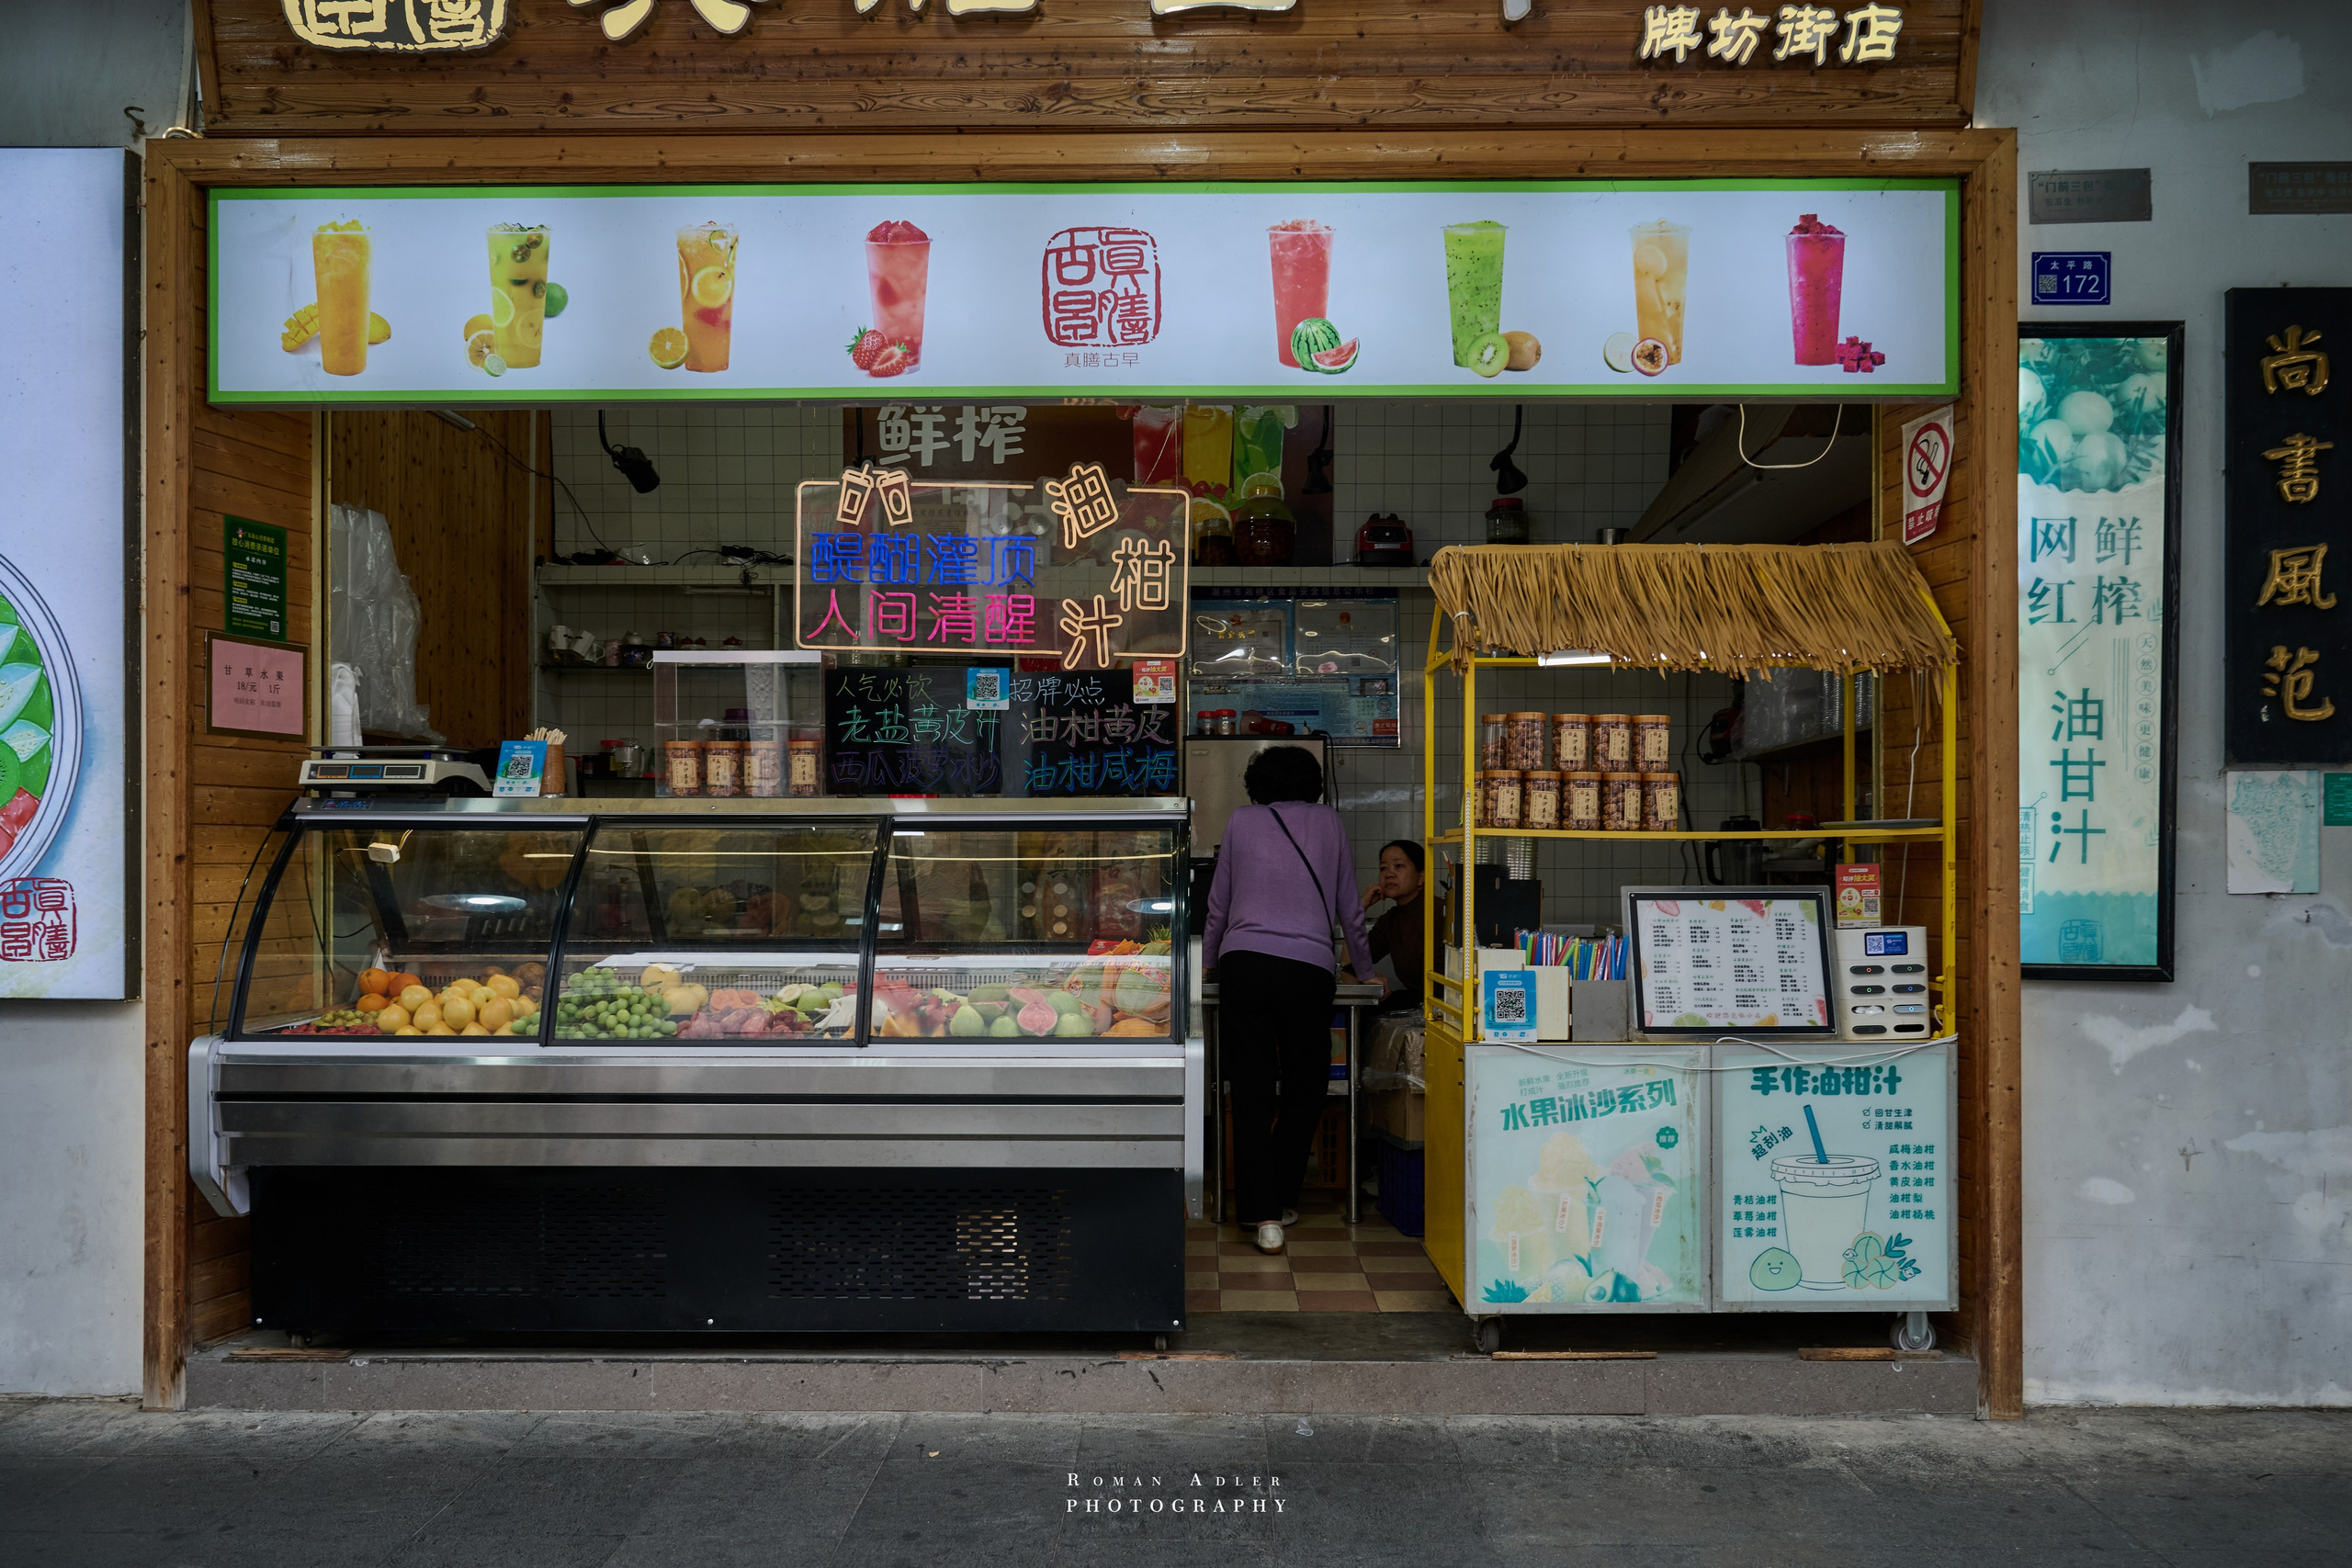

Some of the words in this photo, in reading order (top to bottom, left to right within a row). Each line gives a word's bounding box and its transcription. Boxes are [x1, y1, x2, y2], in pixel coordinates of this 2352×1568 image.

[1640, 3, 1903, 65] 牌坊街店
[2051, 260, 2093, 270] 太平路
[2063, 275, 2100, 293] 172
[1064, 352, 1140, 368] 真膳古早
[876, 406, 1027, 467] 鲜榨
[811, 532, 1036, 587] 醍醐灌顶
[807, 588, 1035, 643] 人间清醒
[224, 665, 284, 681] 甘草水果
[237, 682, 257, 693] 18/元
[268, 684, 281, 694] 1斤
[836, 674, 943, 708] 人气必饮
[1009, 678, 1105, 705] 招牌必点
[2137, 635, 2155, 780] 天然美味更健康
[1020, 704, 1174, 747] 油柑黄皮
[1023, 746, 1179, 792] 油柑咸梅
[2050, 688, 2107, 864] 油甘汁
[1750, 1065, 1903, 1096] 手作油柑汁
[1499, 1078, 1678, 1131] 水果冰沙系列
[1874, 1108, 1913, 1118] 回甘生津
[1874, 1121, 1913, 1131] 清甜解腻
[1751, 1125, 1793, 1161] 超刮油
[1889, 1144, 1936, 1155] 咸梅油柑
[1889, 1160, 1936, 1171] 香水油柑
[1889, 1177, 1936, 1188] 黄皮油柑
[1733, 1194, 1777, 1205] 青桔油柑
[1889, 1193, 1924, 1203] 油柑梨
[1733, 1211, 1777, 1222] 草莓油柑
[1889, 1210, 1936, 1220] 油柑杨桃
[1733, 1226, 1777, 1237] 莲雾油柑
